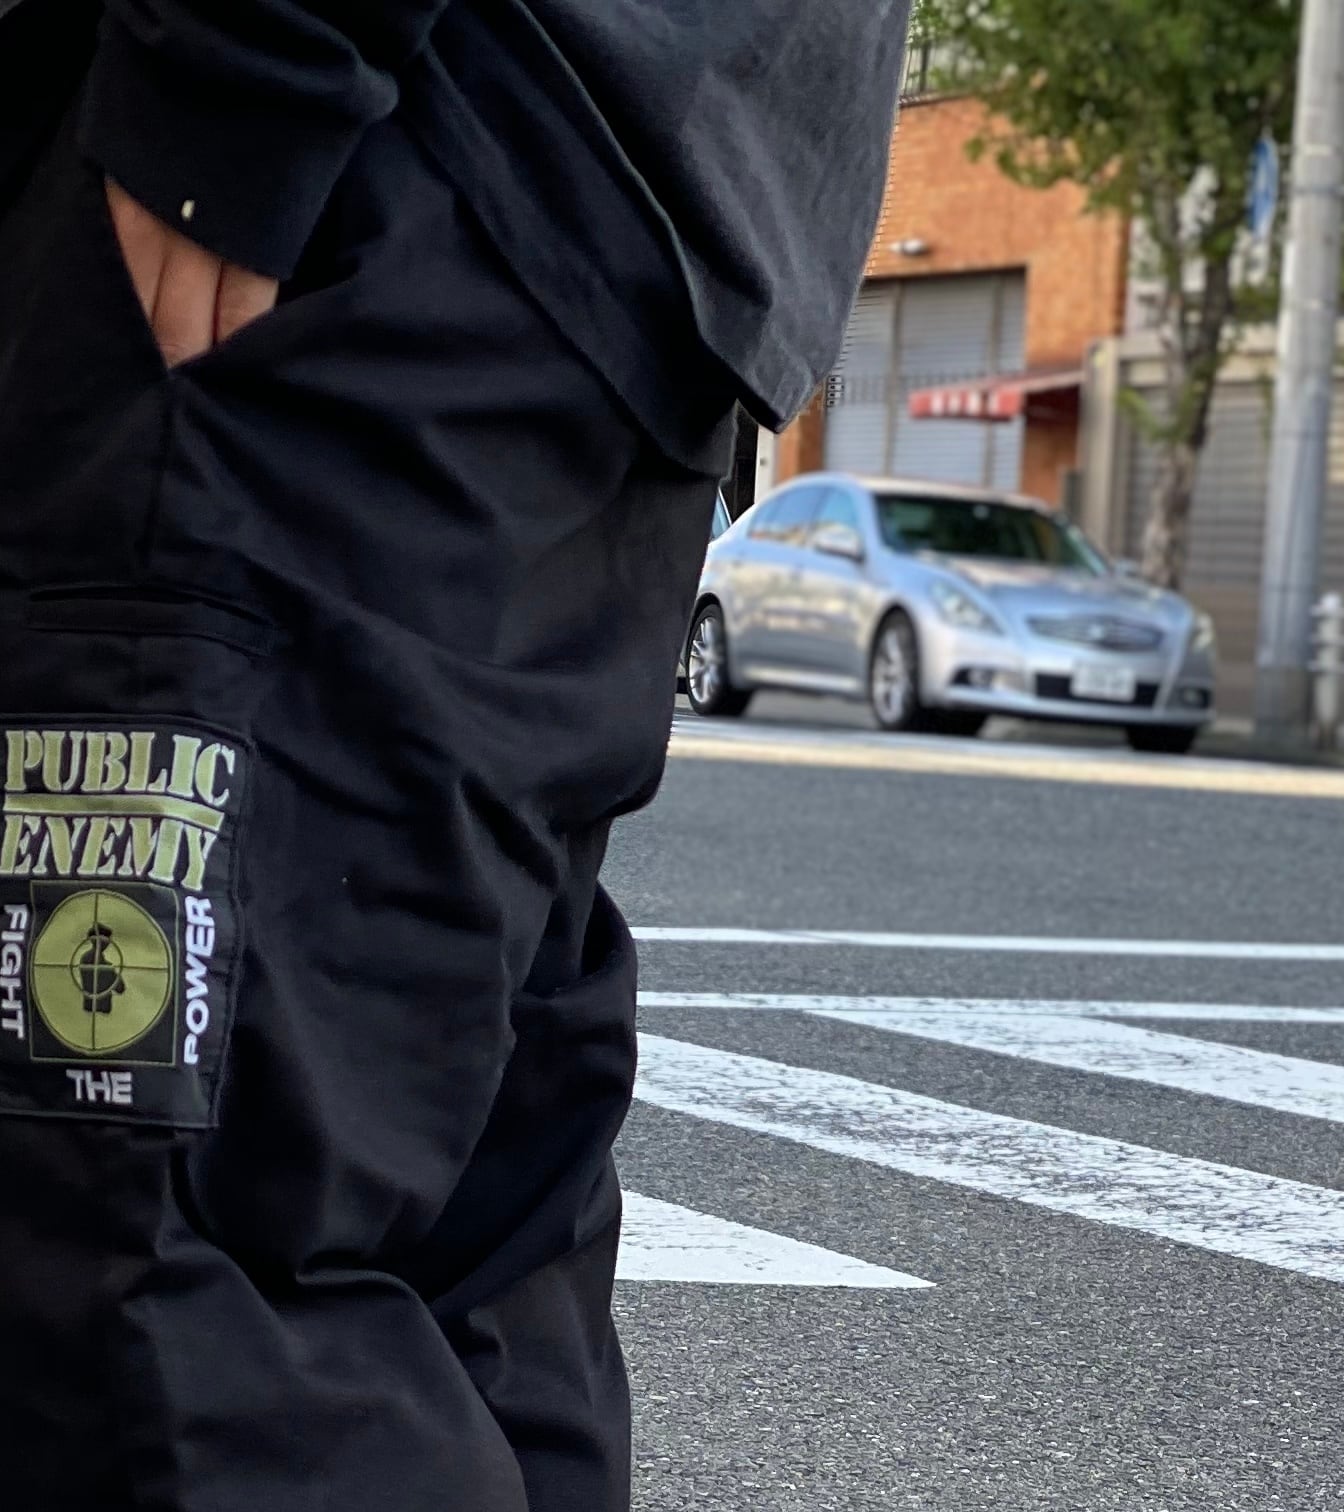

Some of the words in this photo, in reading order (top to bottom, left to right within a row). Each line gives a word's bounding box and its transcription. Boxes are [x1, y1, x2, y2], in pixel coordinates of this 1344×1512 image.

[4, 729, 236, 807] PUBLIC
[184, 896, 215, 1065] POWER
[65, 1068, 132, 1105] THE
